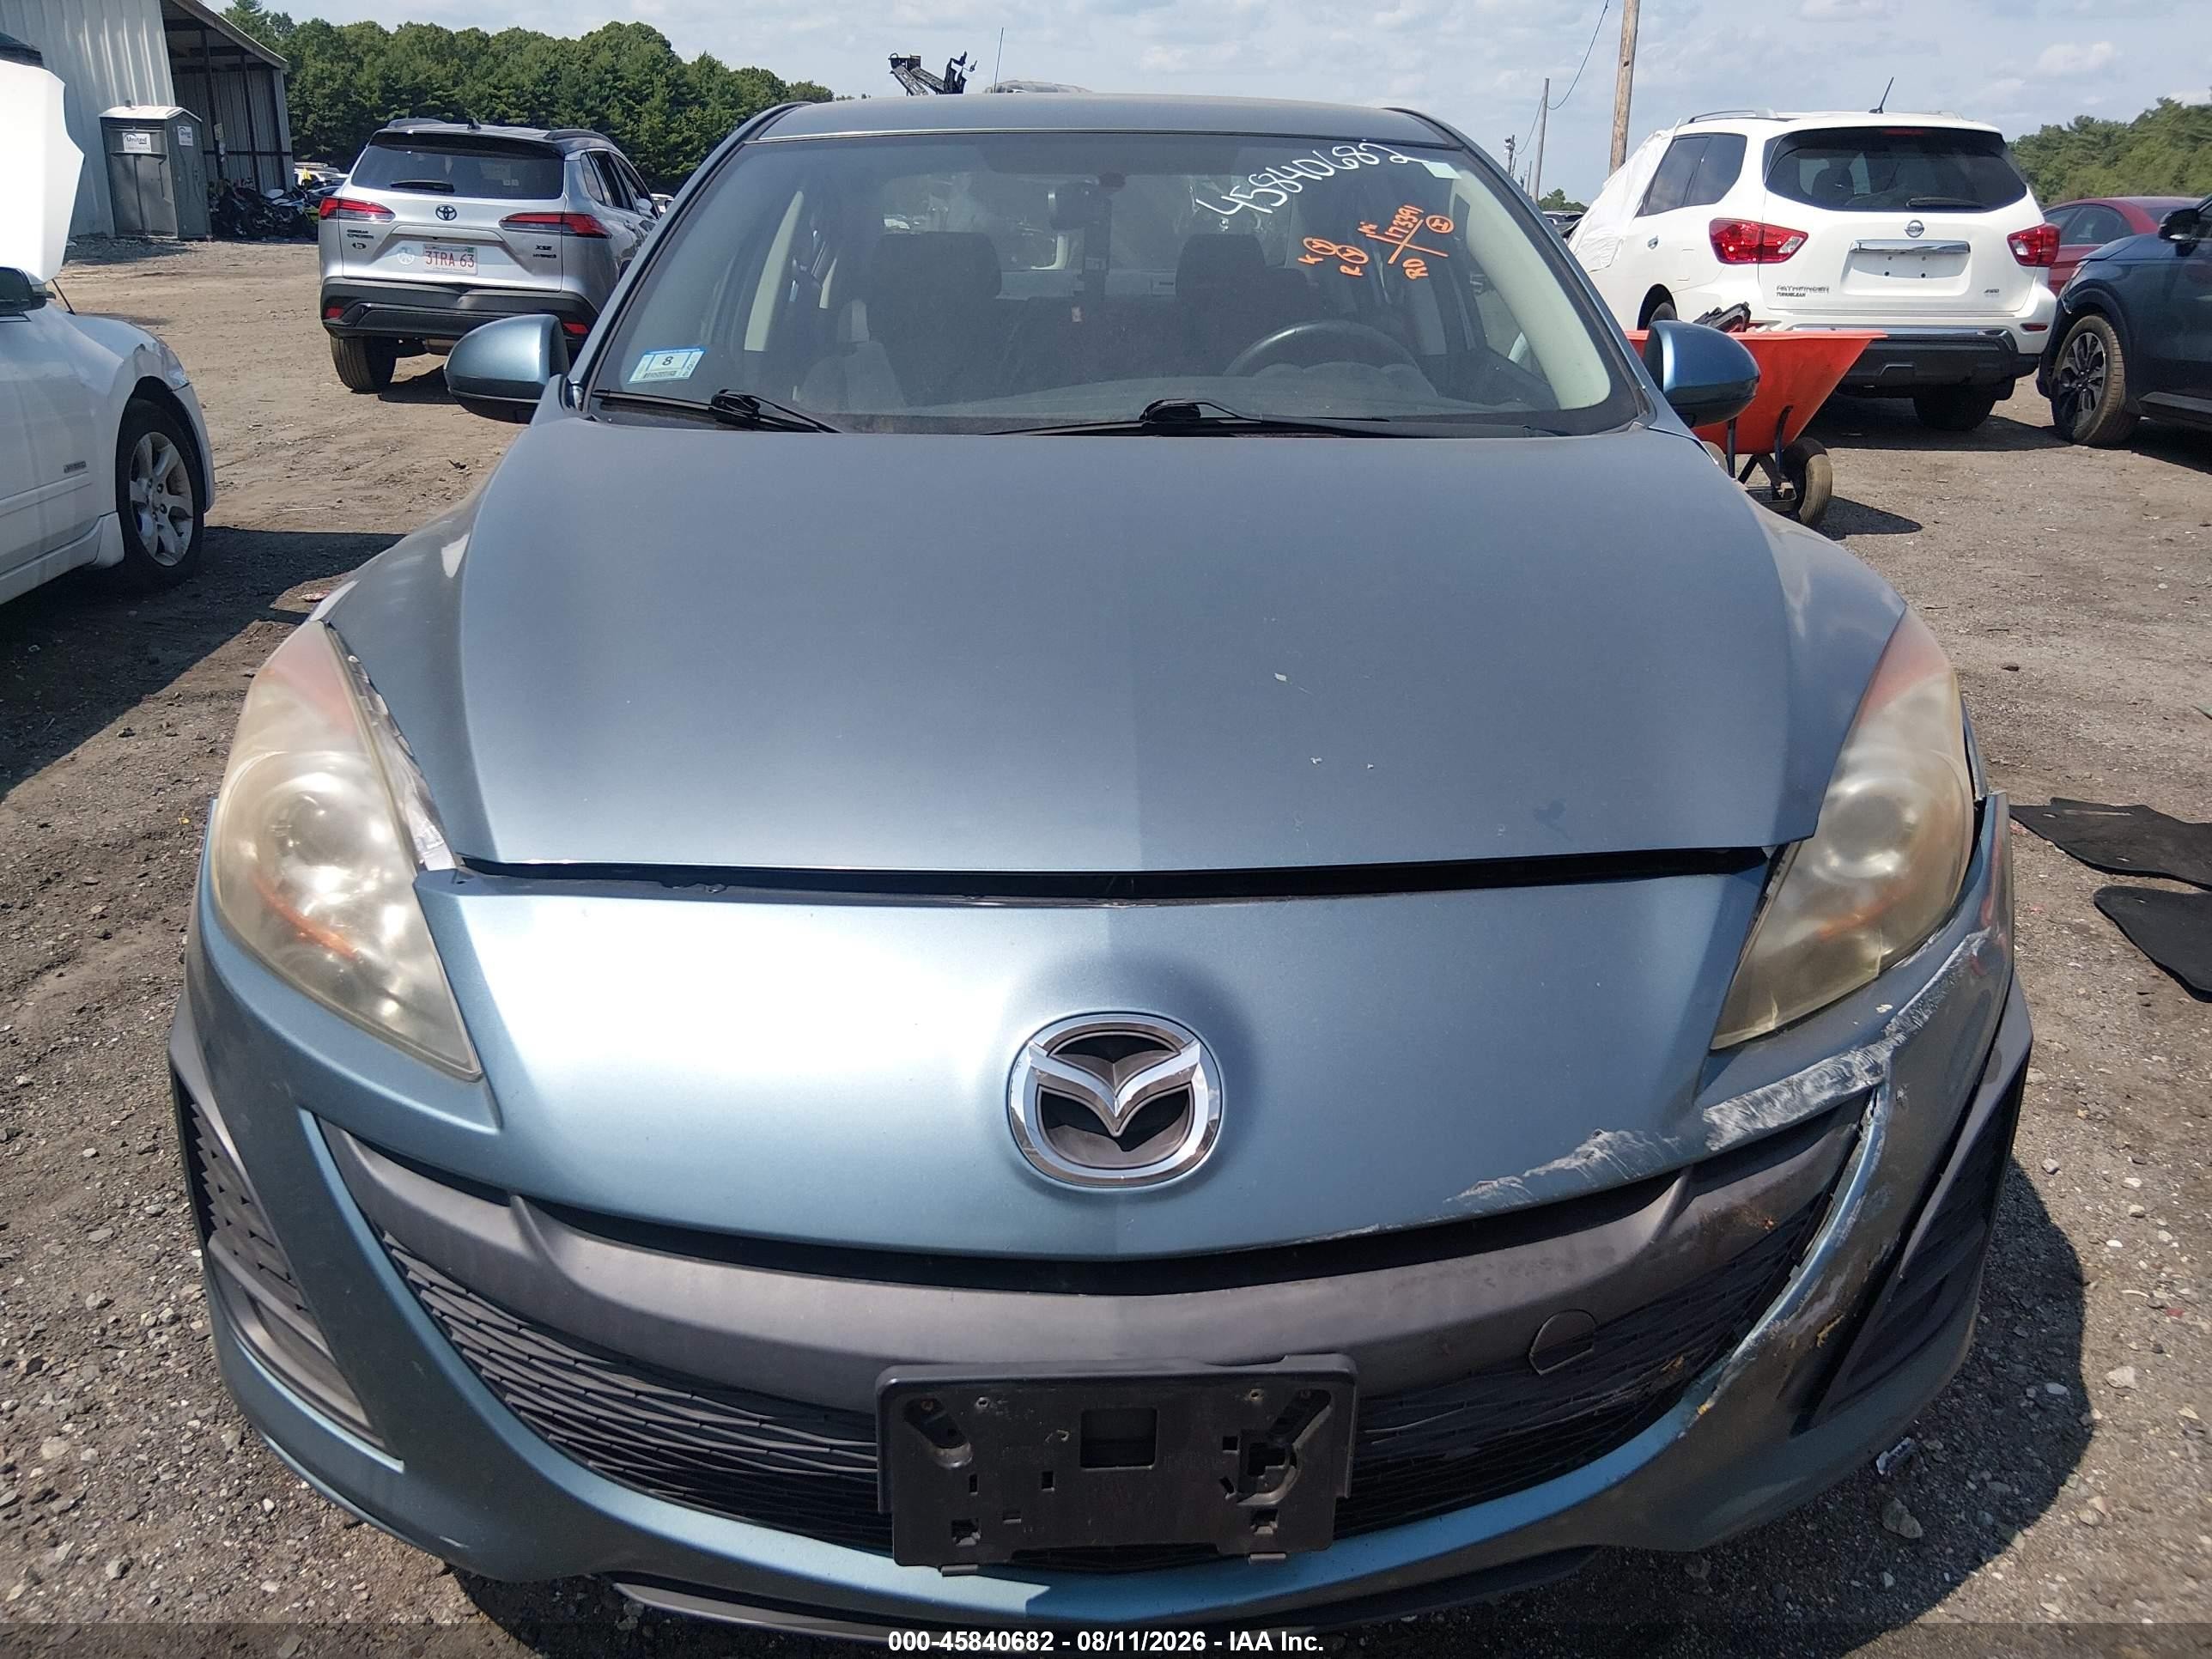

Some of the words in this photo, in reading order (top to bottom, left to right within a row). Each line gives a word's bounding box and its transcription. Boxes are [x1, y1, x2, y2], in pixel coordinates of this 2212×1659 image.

[1195, 142, 1430, 216] 45840682
[1384, 204, 1424, 238] 173391
[425, 251, 455, 267] 3TRA
[459, 253, 475, 268] 63
[662, 356, 674, 366] 8
